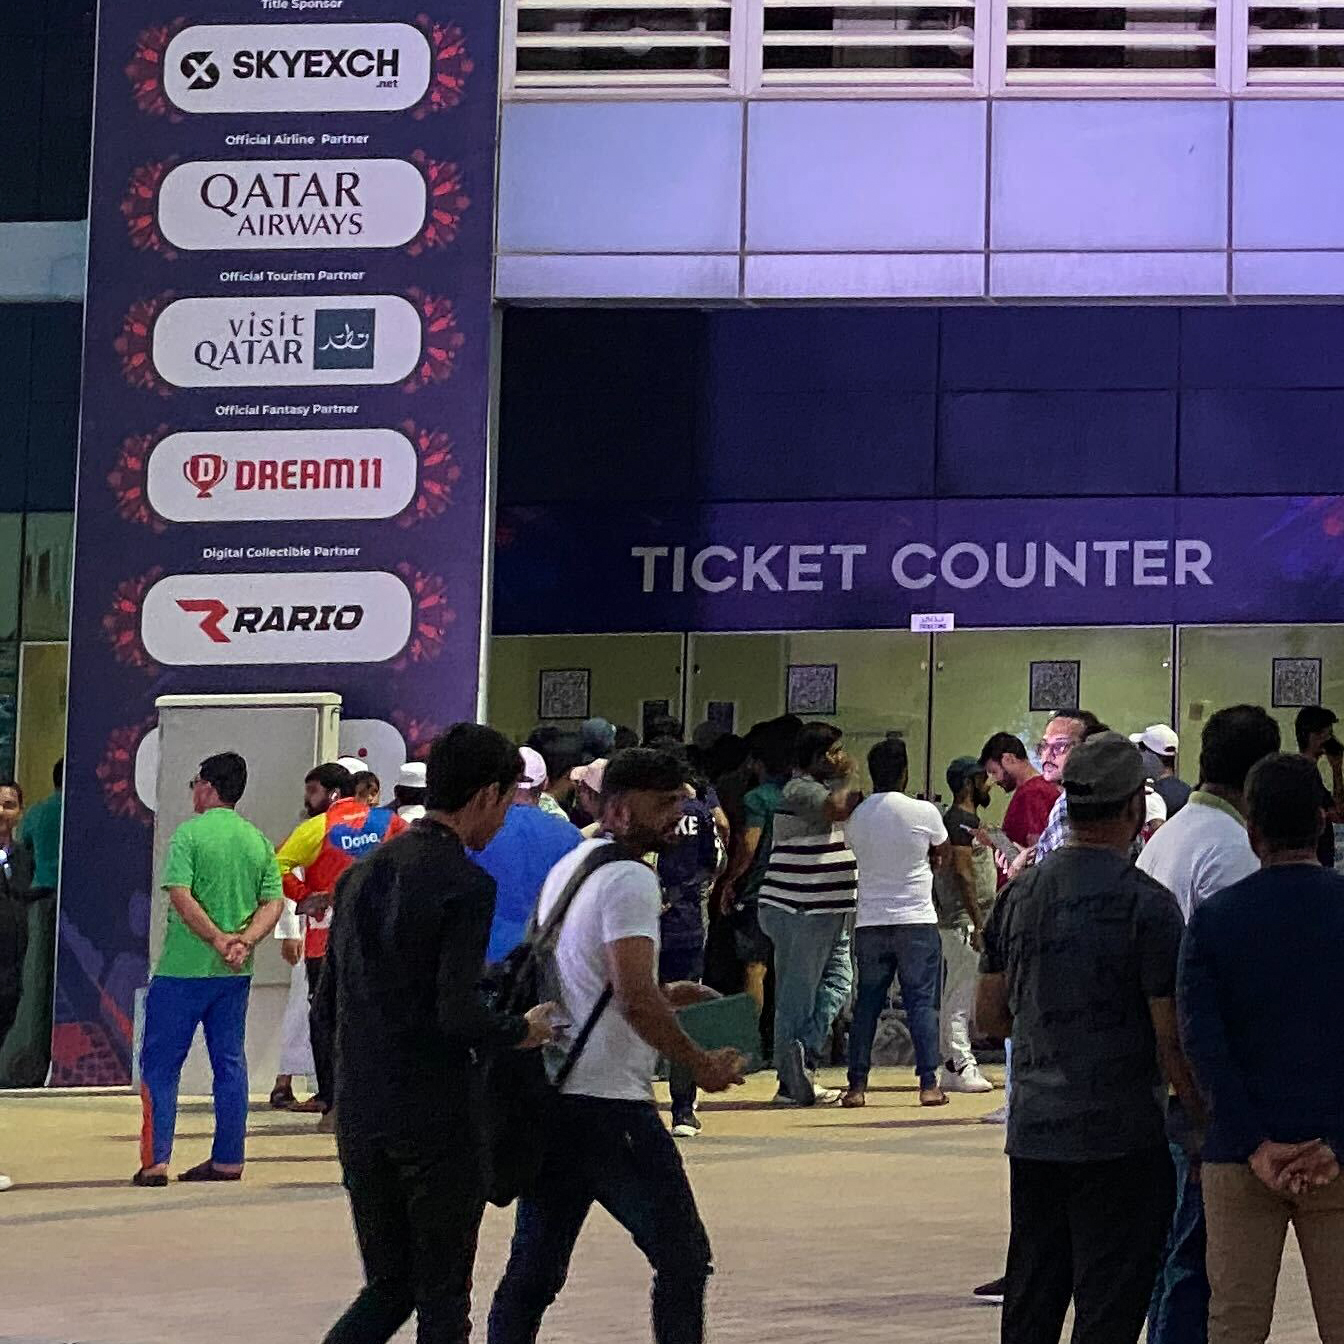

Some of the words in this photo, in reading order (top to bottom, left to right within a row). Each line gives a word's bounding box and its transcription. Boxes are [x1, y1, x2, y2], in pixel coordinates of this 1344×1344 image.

[232, 48, 400, 79] SKYEXCH
[225, 134, 271, 146] Official
[273, 134, 316, 146] Airline
[321, 133, 369, 146] Partner
[200, 171, 364, 218] QATAR
[237, 213, 364, 237] AIRWAYS
[219, 270, 264, 283] Official
[266, 270, 315, 282] Tourism
[318, 269, 366, 281] Partner
[228, 311, 305, 338] visit
[193, 339, 304, 371] QATAR
[215, 404, 260, 417] Official
[261, 404, 310, 419] Fantasy
[312, 403, 360, 416] Partner
[234, 457, 383, 491] DREAM11
[202, 547, 244, 560] Digital
[246, 546, 311, 559] Collectible
[314, 545, 361, 558] Partner
[631, 543, 867, 593] TICKET
[891, 539, 1213, 590] COUNTER
[232, 604, 365, 634] RARIO
